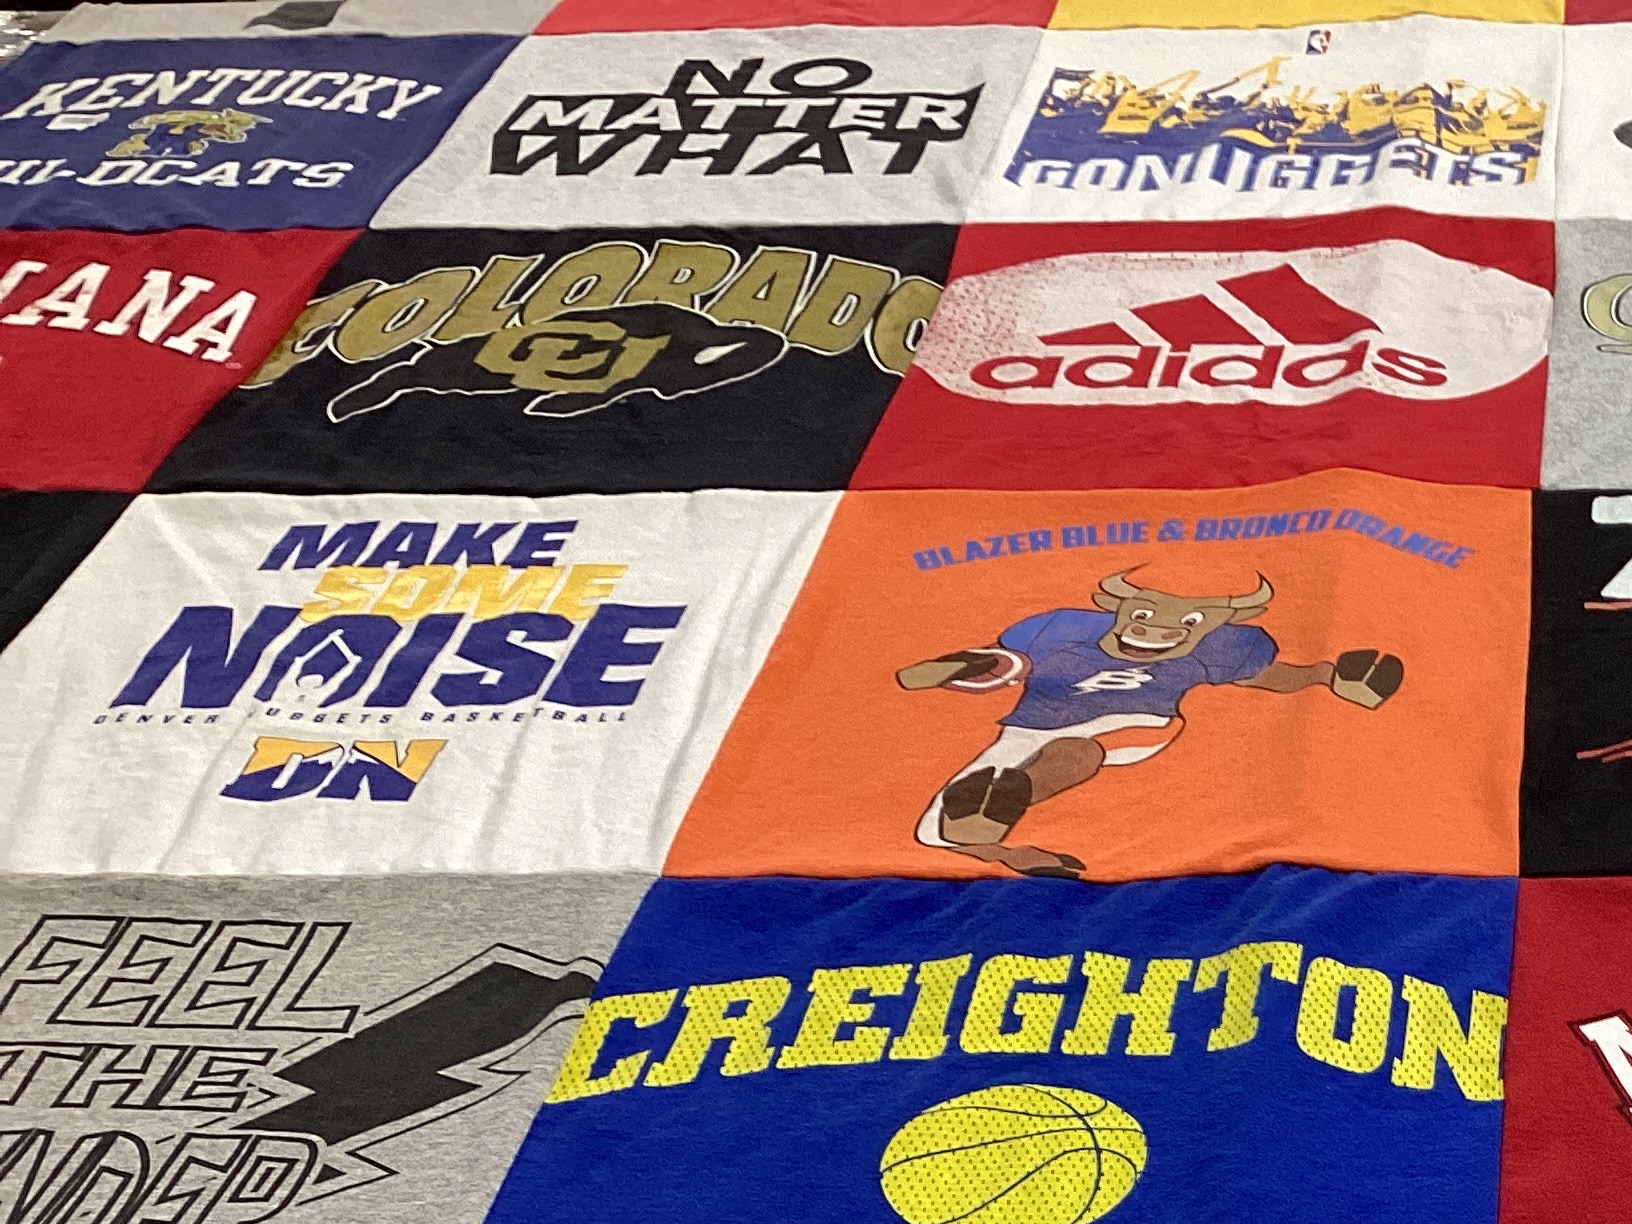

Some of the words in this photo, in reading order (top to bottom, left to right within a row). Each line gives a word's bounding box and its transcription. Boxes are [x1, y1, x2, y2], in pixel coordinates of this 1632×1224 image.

[2, 67, 443, 121] KENTUCKY
[663, 57, 873, 96] NO
[508, 96, 968, 131] MATTER
[489, 130, 965, 176] WHAT
[258, 520, 579, 570] MAKE
[911, 528, 1054, 572] BLAZER
[1061, 520, 1149, 549] BLUE
[1157, 517, 1186, 543] &
[1194, 508, 1333, 541] BRONCO
[1334, 508, 1477, 570] ORANGE
[300, 564, 628, 623] SOME
[109, 603, 689, 709] NOISE
[93, 712, 220, 725] DENVER
[247, 706, 392, 725] UGGETS
[420, 706, 627, 723] BASKETBALL
[0, 914, 359, 1032] FEEL
[546, 940, 1510, 1105] CREIGHTON
[0, 1042, 277, 1112] THE
